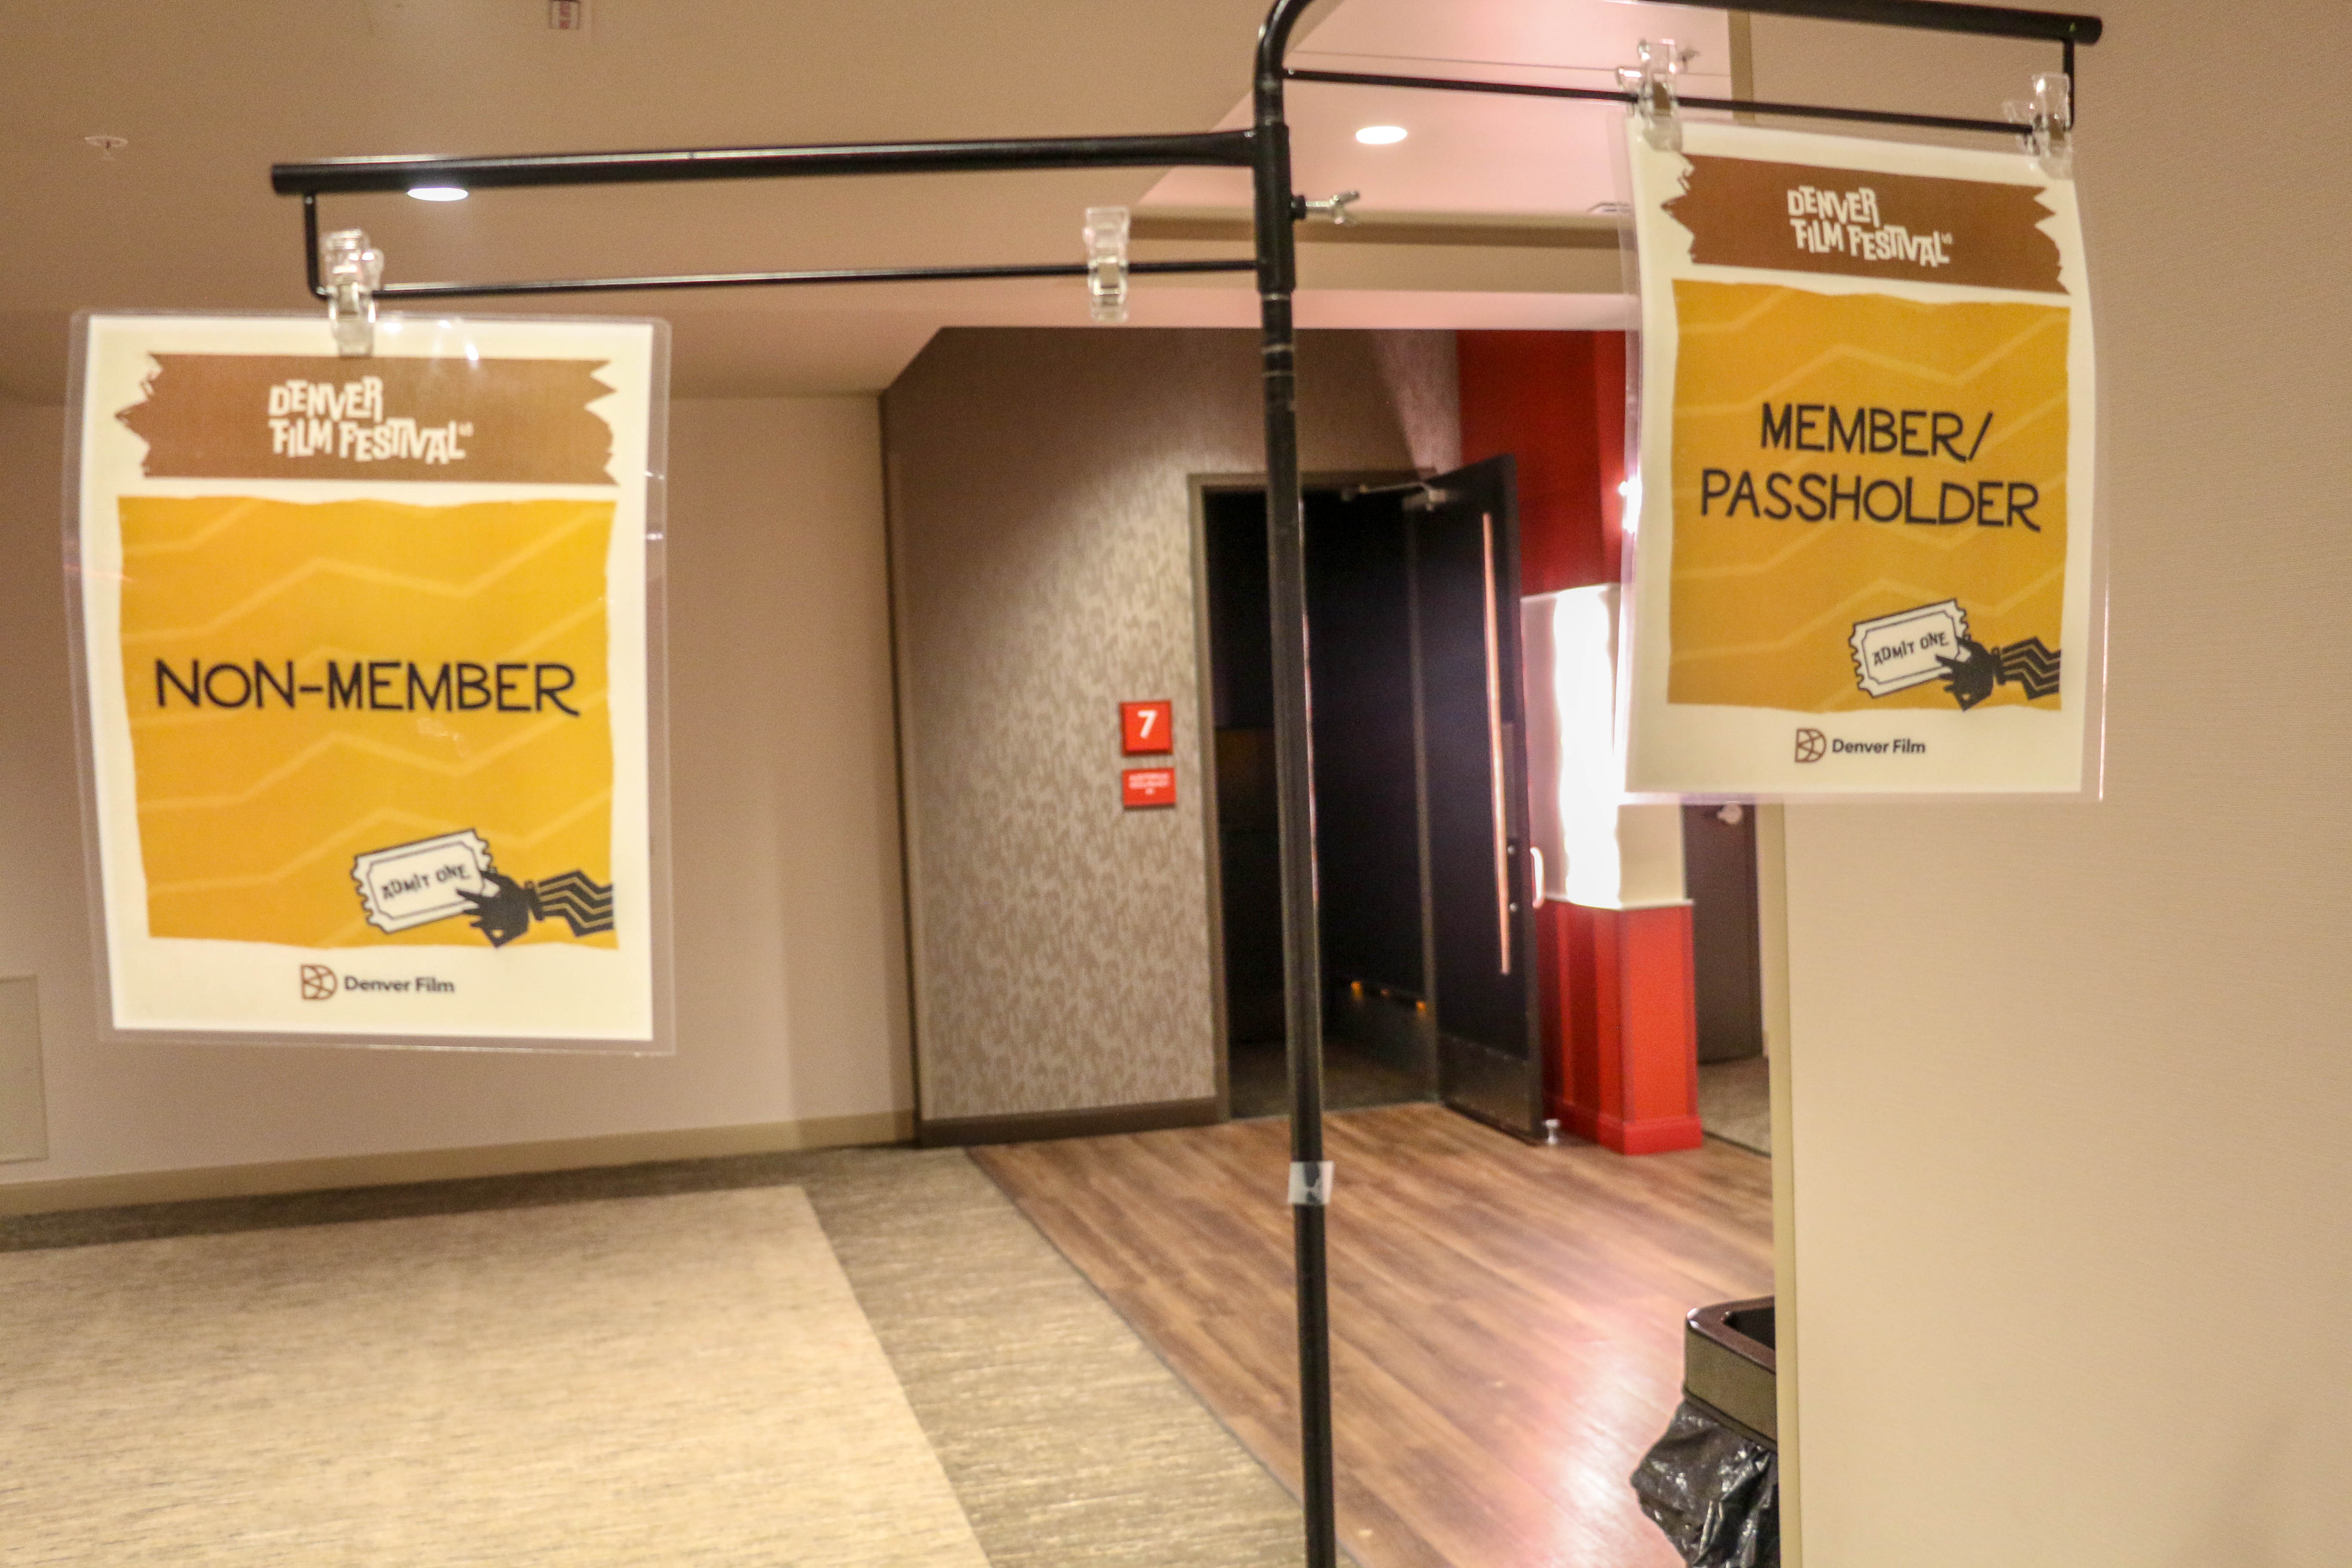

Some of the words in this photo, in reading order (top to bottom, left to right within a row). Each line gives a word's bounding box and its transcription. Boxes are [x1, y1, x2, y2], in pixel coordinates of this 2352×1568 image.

[1787, 185, 1880, 228] DENVER
[1790, 218, 1844, 253] FILM
[1847, 224, 1950, 268] FESTIVAL
[269, 376, 383, 422] DENVER
[269, 419, 333, 458] FILM
[339, 417, 466, 465] FESTIVAL
[1760, 402, 1994, 462] MEMBER/
[1700, 468, 2041, 532] PASSHOLDER
[1872, 640, 1915, 667] ADMIT
[1920, 631, 1950, 649] ONE
[154, 657, 580, 717] NON-MEMBER
[1137, 709, 1158, 739] 7
[1832, 738, 1890, 753] Denver
[1893, 738, 1926, 753] Film
[381, 873, 430, 900] ADMIT
[436, 864, 471, 883] ONE
[344, 976, 410, 992] Denver
[415, 977, 454, 992] Film
